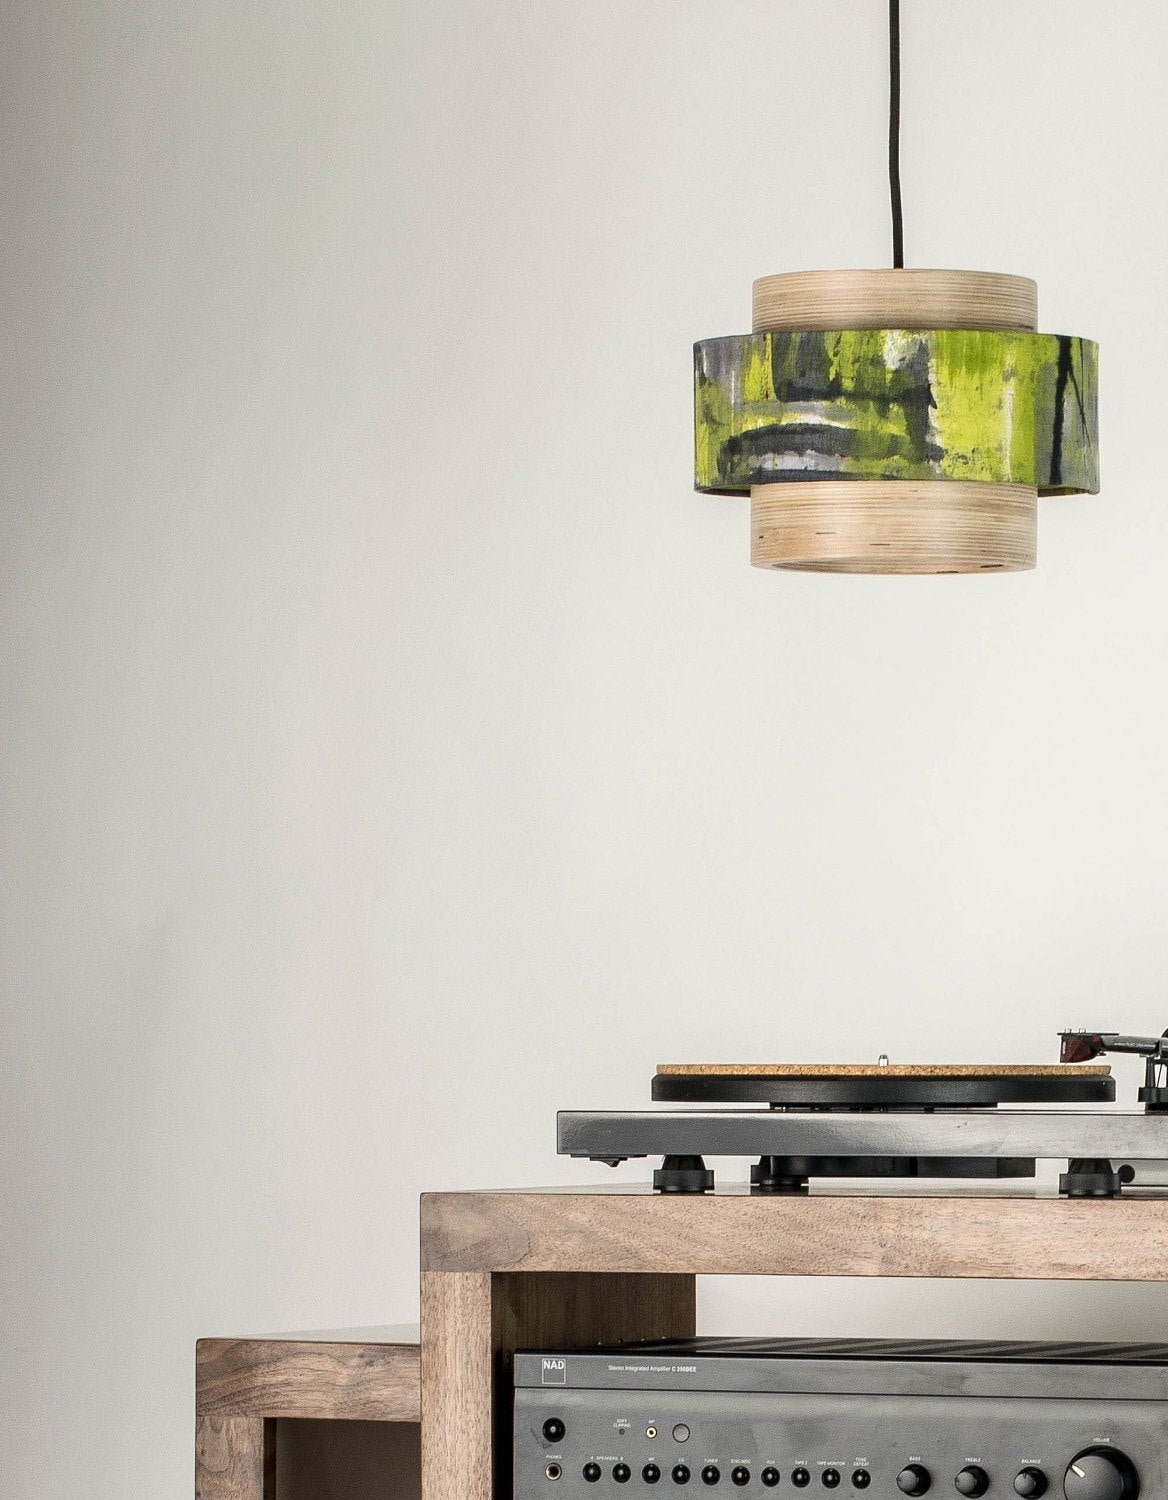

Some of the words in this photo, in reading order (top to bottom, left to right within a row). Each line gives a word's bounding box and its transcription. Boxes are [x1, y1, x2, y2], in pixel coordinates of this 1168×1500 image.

[543, 1360, 565, 1370] NAD
[625, 1365, 649, 1373] Integrated
[650, 1365, 671, 1373] Amplifier
